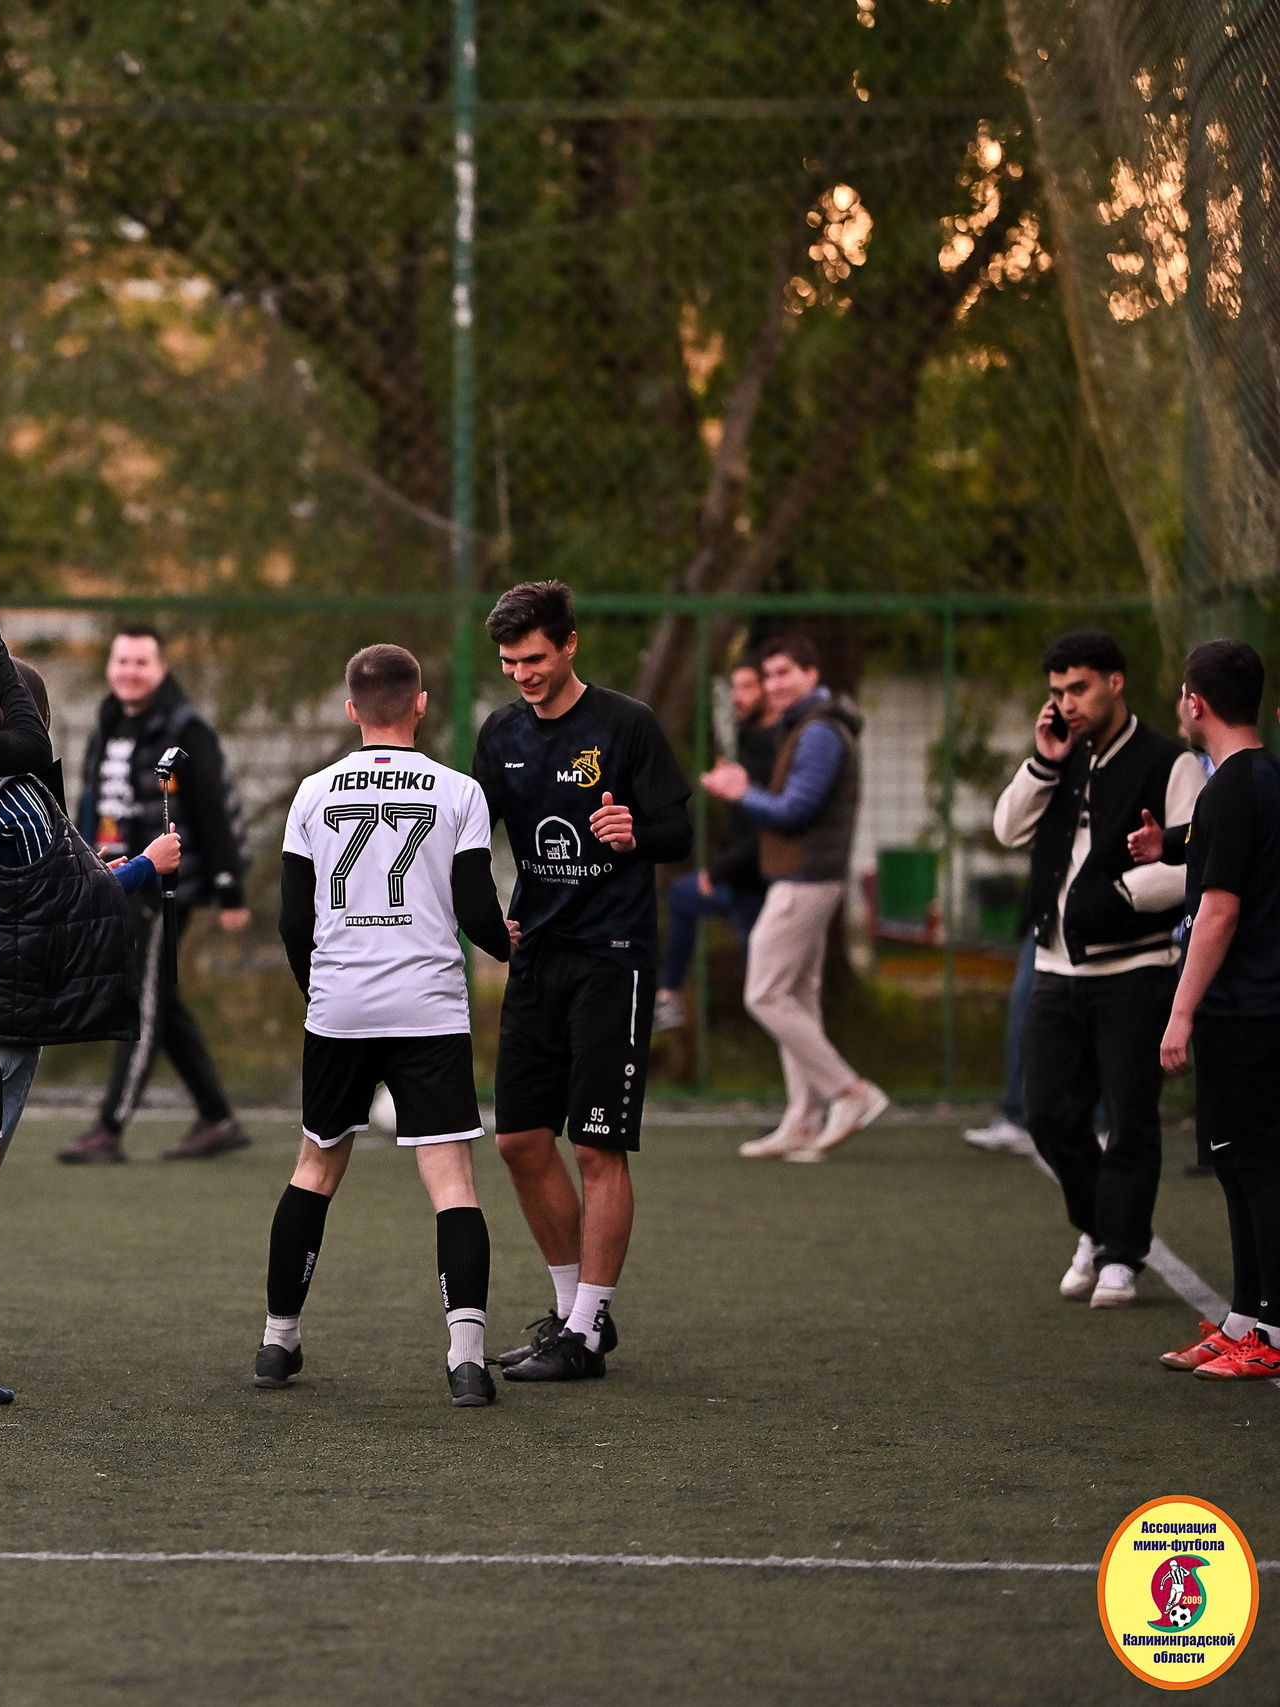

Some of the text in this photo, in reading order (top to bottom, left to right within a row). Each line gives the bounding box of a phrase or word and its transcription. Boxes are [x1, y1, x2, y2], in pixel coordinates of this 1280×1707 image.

[329, 770, 435, 793] ЛЕВЧЕНКО
[557, 770, 583, 782] МиП
[324, 803, 437, 909] 77
[521, 859, 613, 877] ПЗИТИВИНФО
[345, 915, 412, 926] ПЕНАЛЬТИ.РФ
[590, 1107, 605, 1122] 95
[582, 1122, 610, 1135] JAKO
